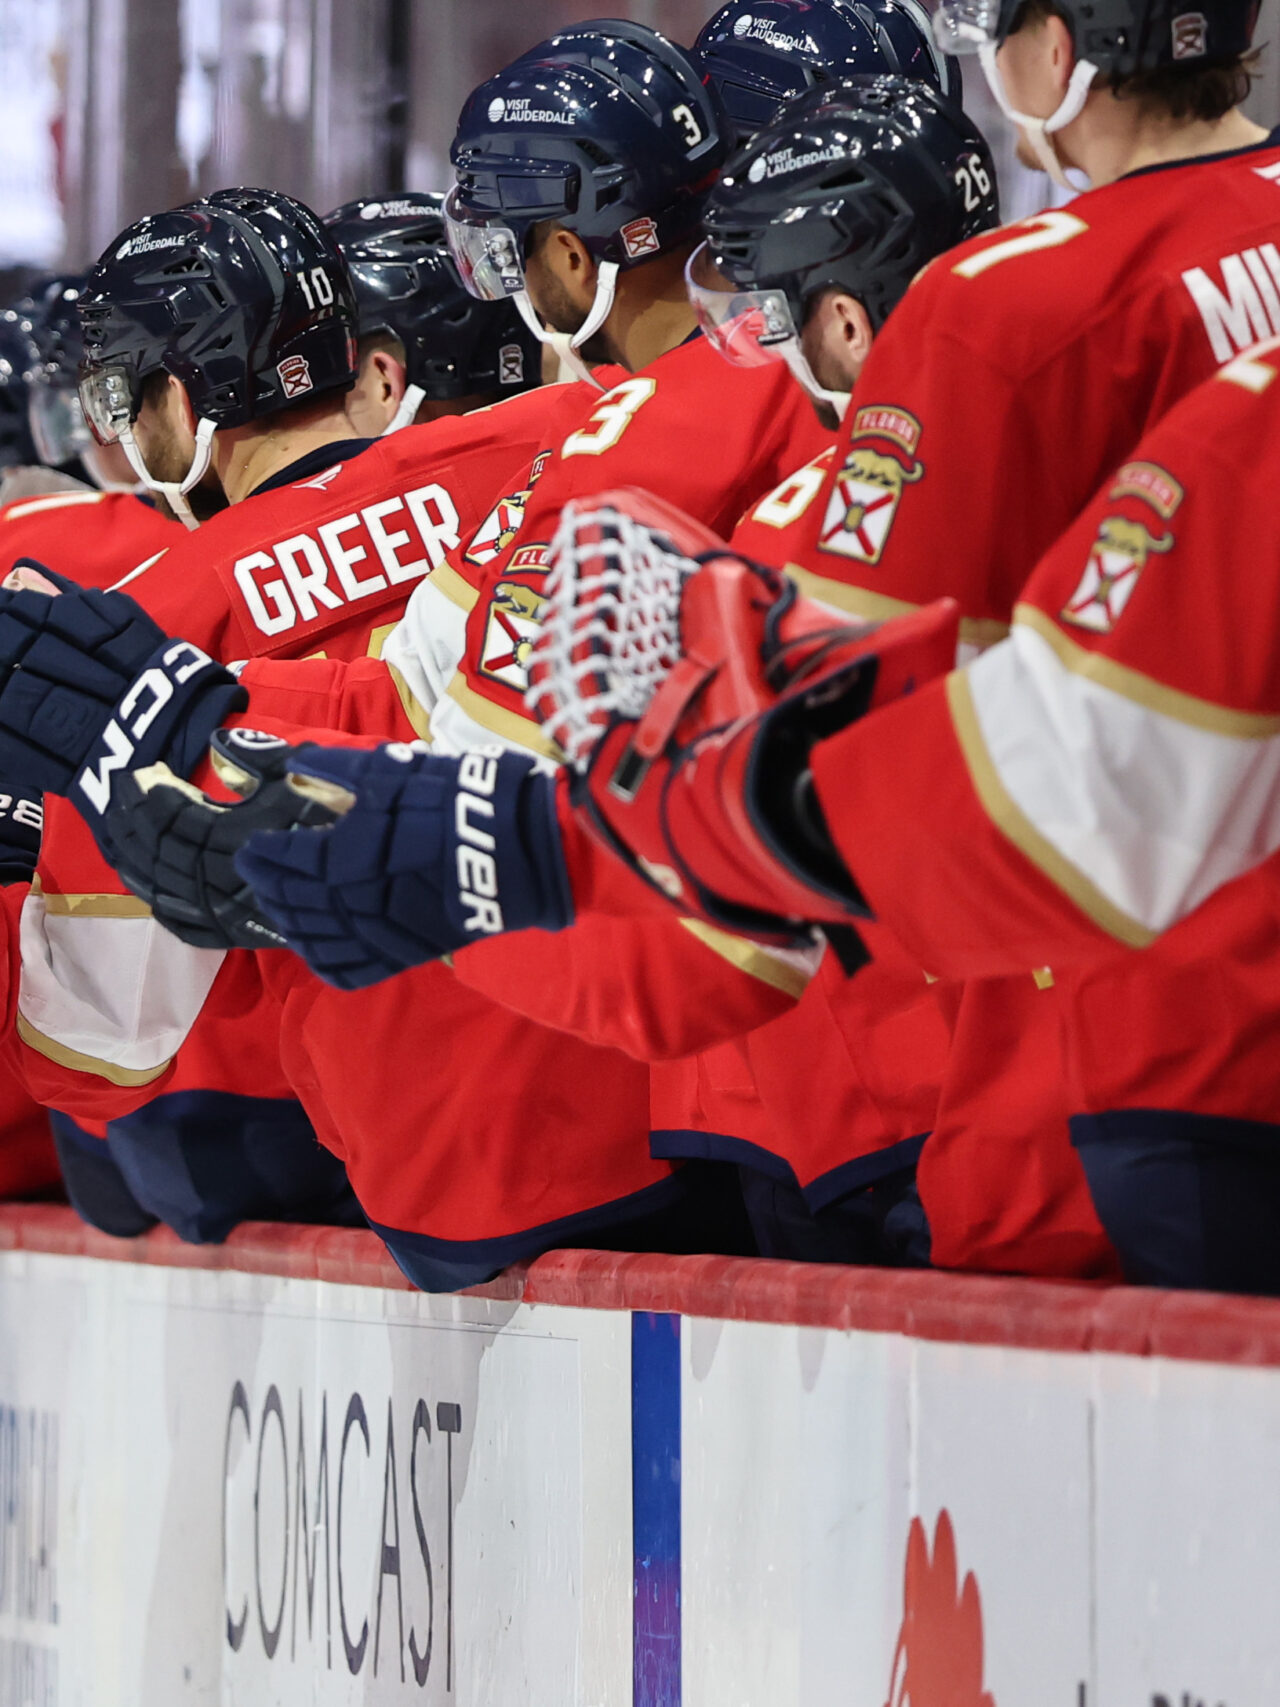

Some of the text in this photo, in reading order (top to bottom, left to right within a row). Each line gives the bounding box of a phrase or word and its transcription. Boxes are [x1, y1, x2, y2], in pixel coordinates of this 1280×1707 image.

[752, 17, 777, 30] VISIT
[746, 29, 812, 52] LAUDERDALE
[504, 110, 576, 125] LAUDERDALE
[506, 98, 531, 110] VISIT
[672, 104, 702, 147] 3
[767, 148, 793, 165] VISIT
[955, 154, 991, 212] 26
[127, 235, 186, 257] LAUDERDALE
[131, 232, 153, 246] VISIT
[297, 266, 334, 310] 10
[561, 377, 657, 460] 3
[233, 483, 462, 636] GREER
[79, 641, 213, 815] CCM
[224, 1379, 462, 1692] COMCAST
